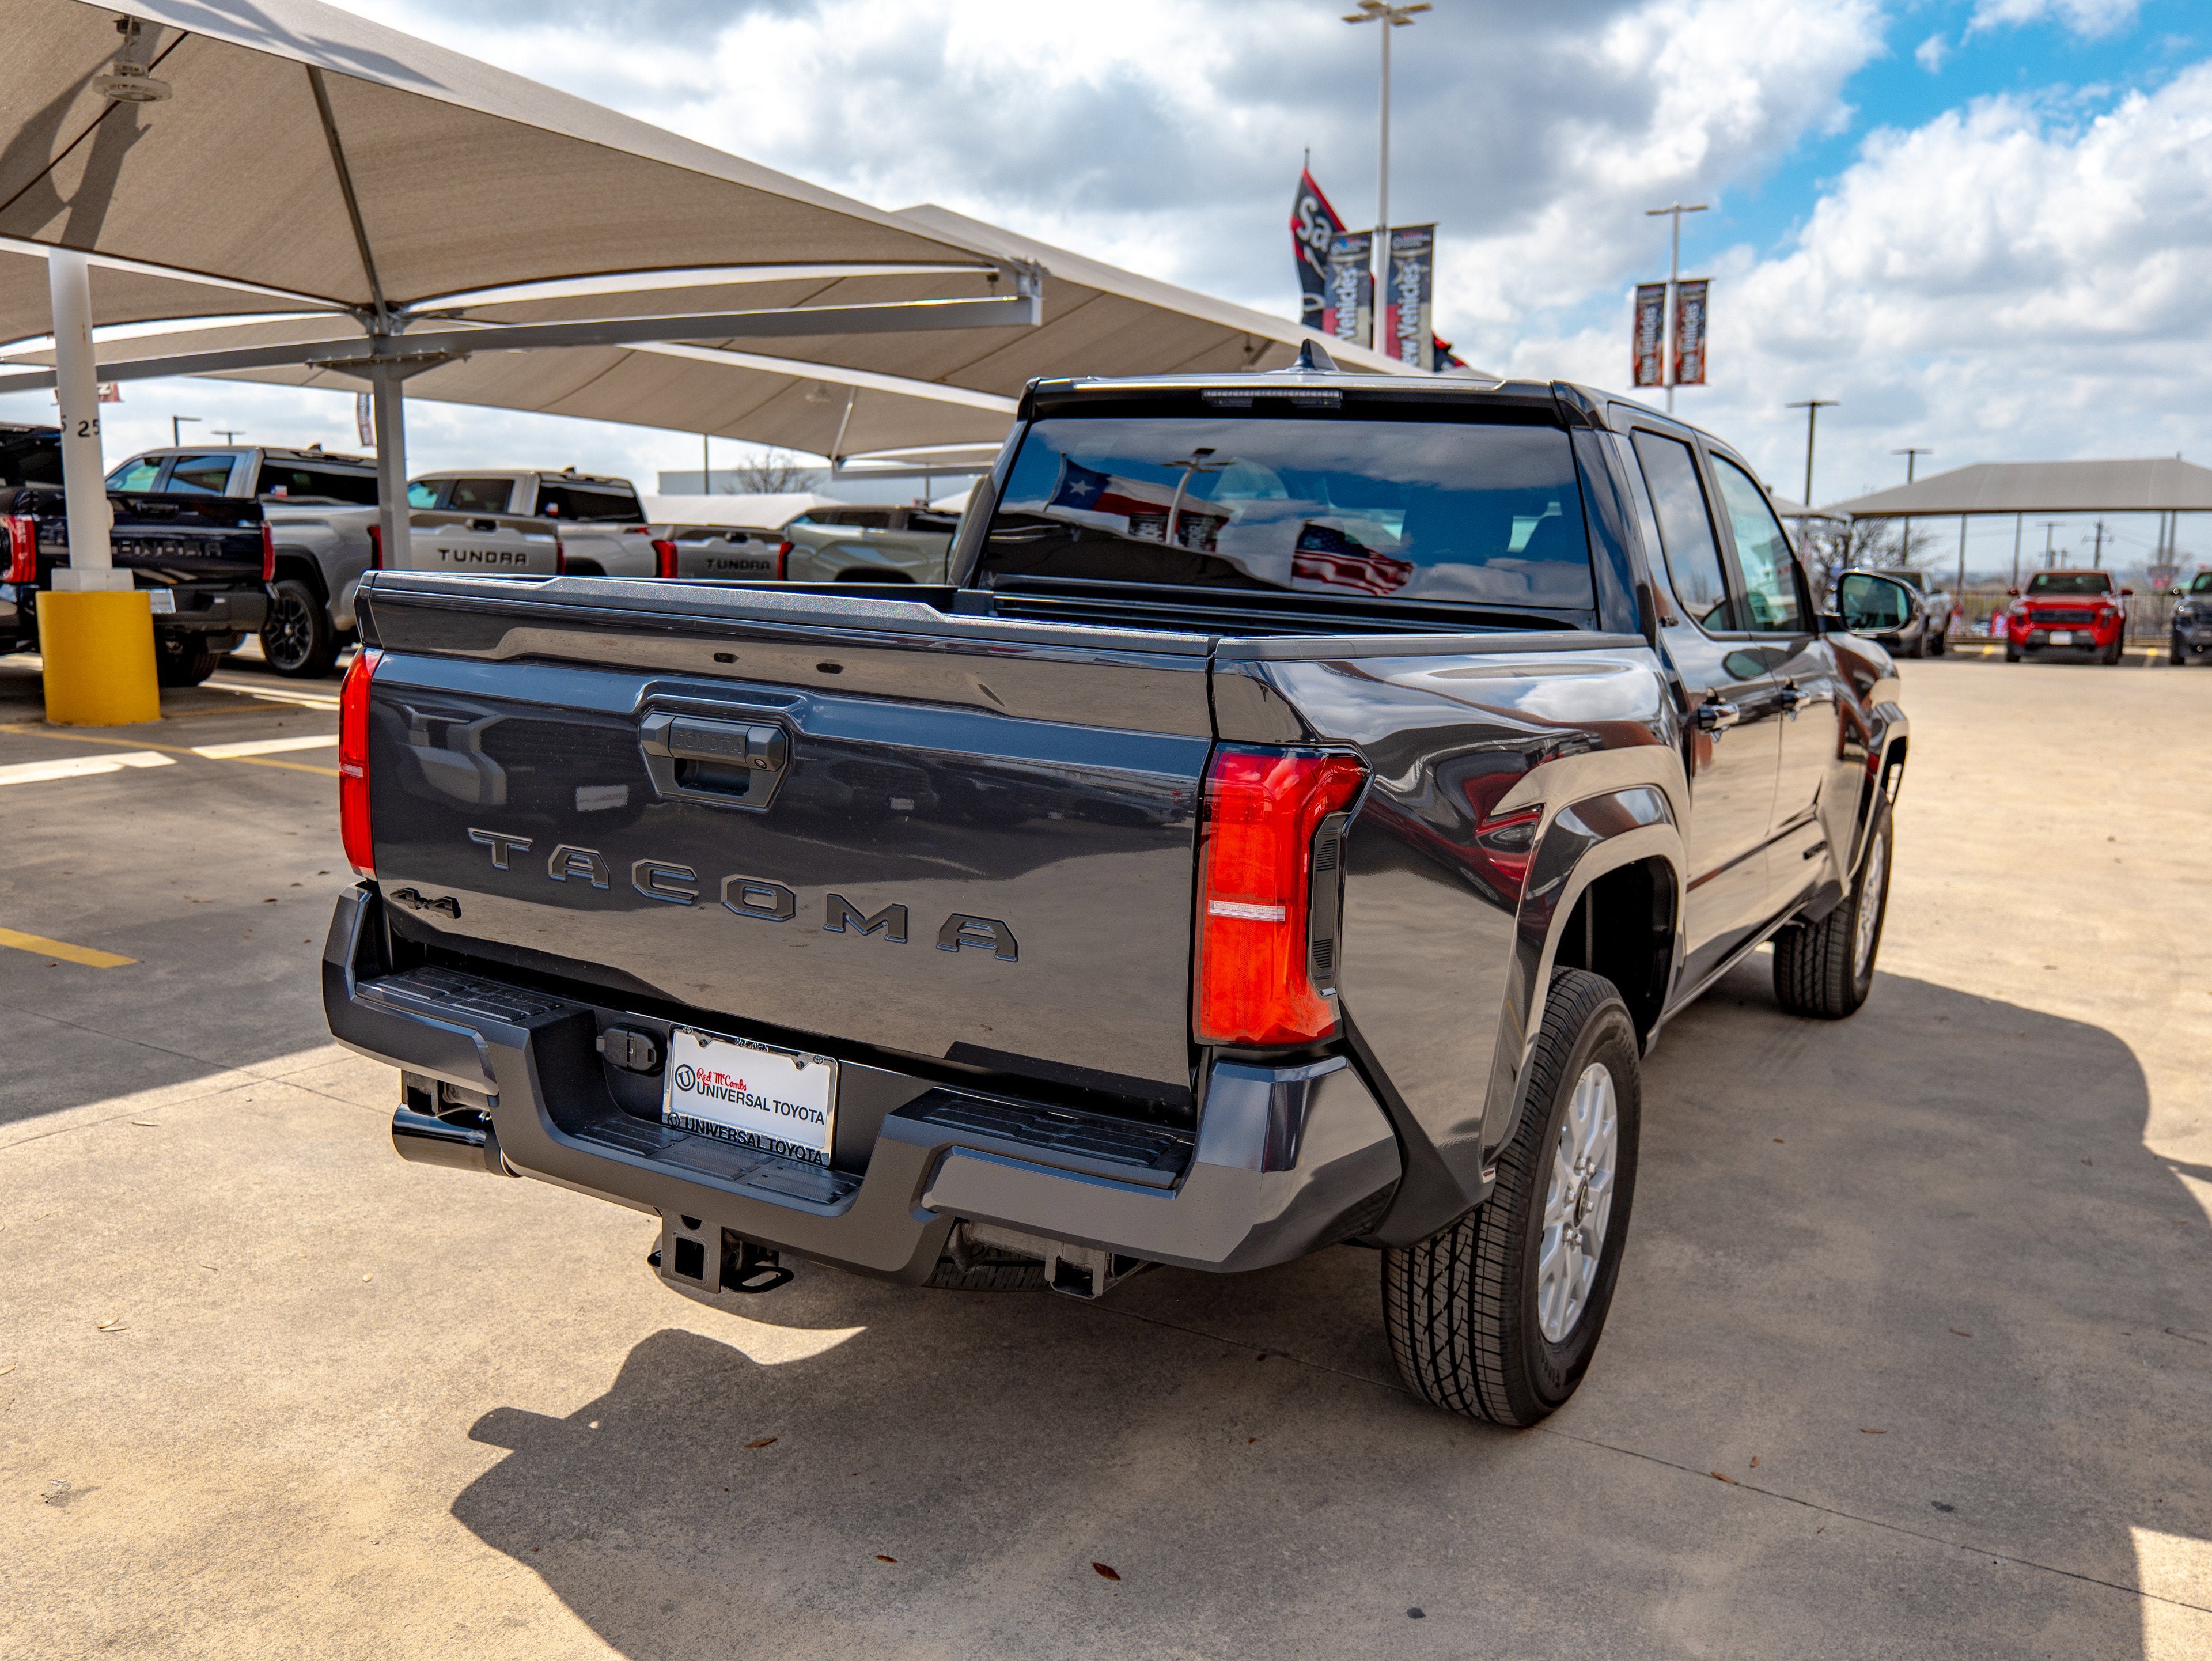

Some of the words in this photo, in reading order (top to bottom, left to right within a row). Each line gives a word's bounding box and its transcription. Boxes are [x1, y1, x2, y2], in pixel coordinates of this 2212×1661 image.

[1396, 262, 1421, 338] Vehicles
[1401, 338, 1421, 367] ew
[78, 419, 100, 438] 25
[117, 540, 222, 558] UNDRA
[437, 548, 528, 566] TUNDRA
[706, 558, 772, 573] TUNDRA
[672, 730, 743, 755] TOYOTA
[467, 827, 1019, 963] TACOMA
[696, 1067, 712, 1087] Red
[713, 1071, 748, 1092] McCombs
[696, 1081, 771, 1112] UNIVERSAL
[772, 1099, 825, 1126] TOYOTA
[684, 1115, 766, 1149] UNIVERSAL
[767, 1137, 824, 1166] TOYOTA
